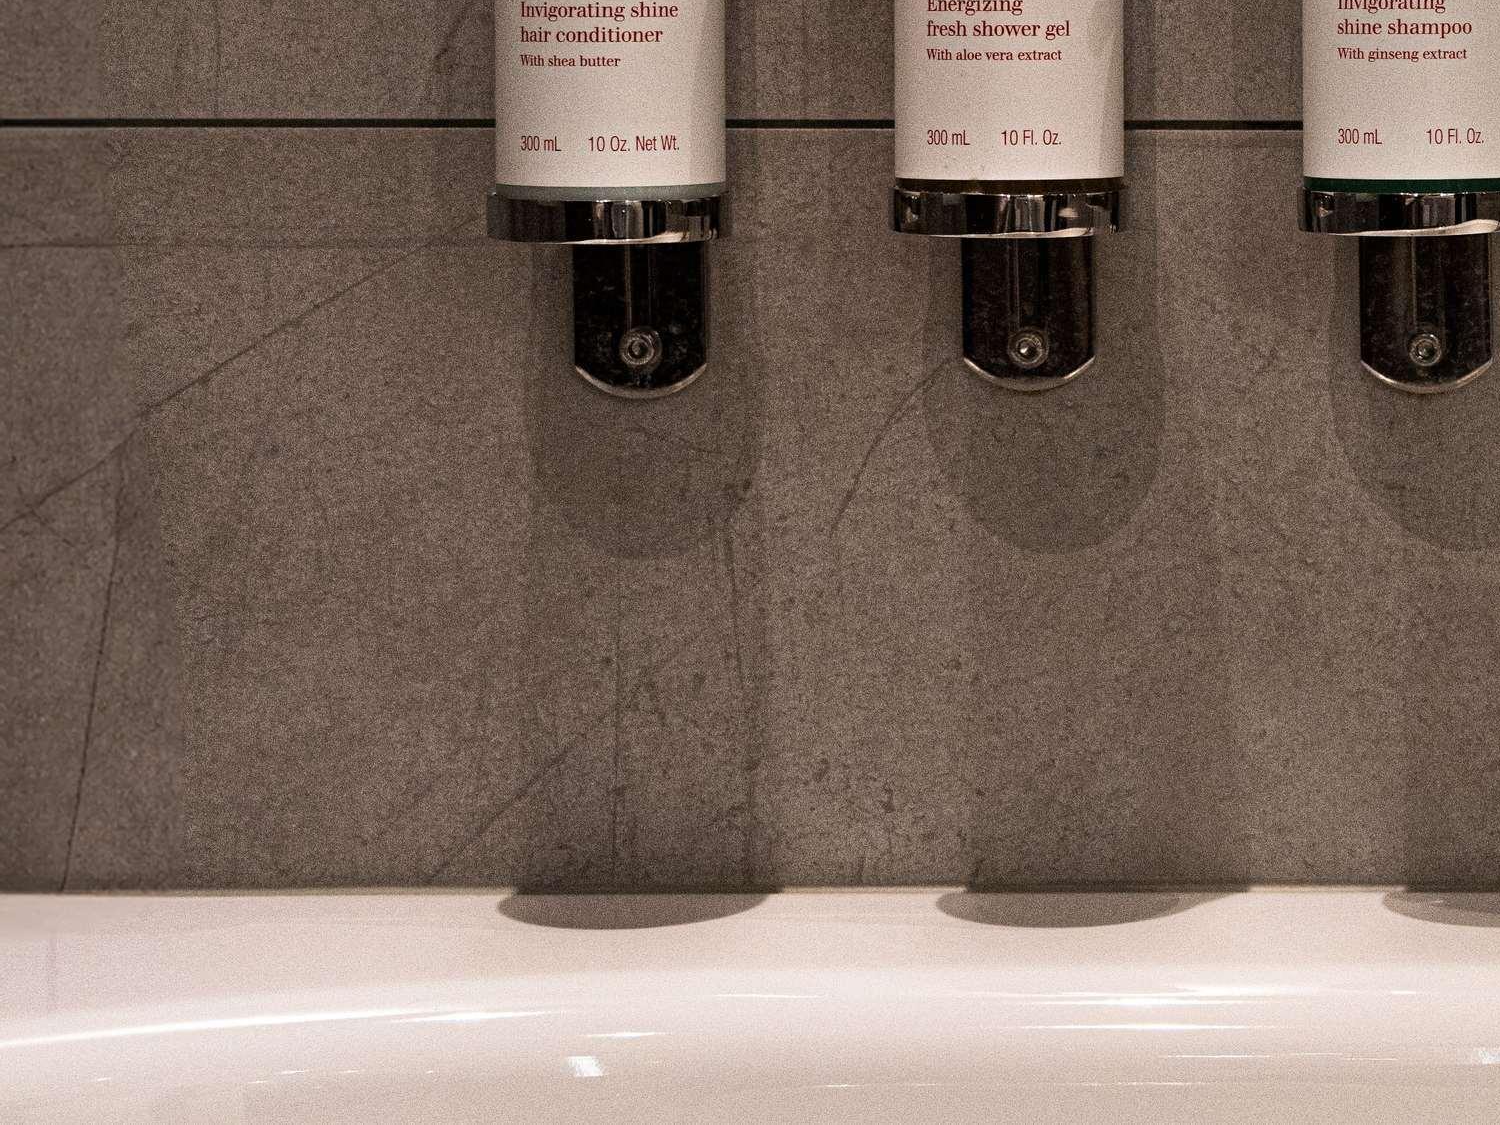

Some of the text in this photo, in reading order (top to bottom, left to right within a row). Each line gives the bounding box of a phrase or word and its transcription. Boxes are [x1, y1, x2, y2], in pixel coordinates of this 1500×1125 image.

[520, 1, 679, 22] Invigorating shine
[520, 26, 664, 43] hair conditioner
[926, 20, 1070, 41] fresh shower gel
[1337, 18, 1473, 39] shine shampoo
[520, 54, 622, 67] With shea butter
[926, 48, 1062, 61] With aloe vera extract
[1337, 47, 1468, 63] With ginseng extract
[520, 134, 680, 152] 300 mL 10 Oz. Net Wt.
[926, 129, 1062, 146] 300 mL 10 Fl. Oz.
[1338, 128, 1485, 145] 300 mL 10 Fl. Oz.
